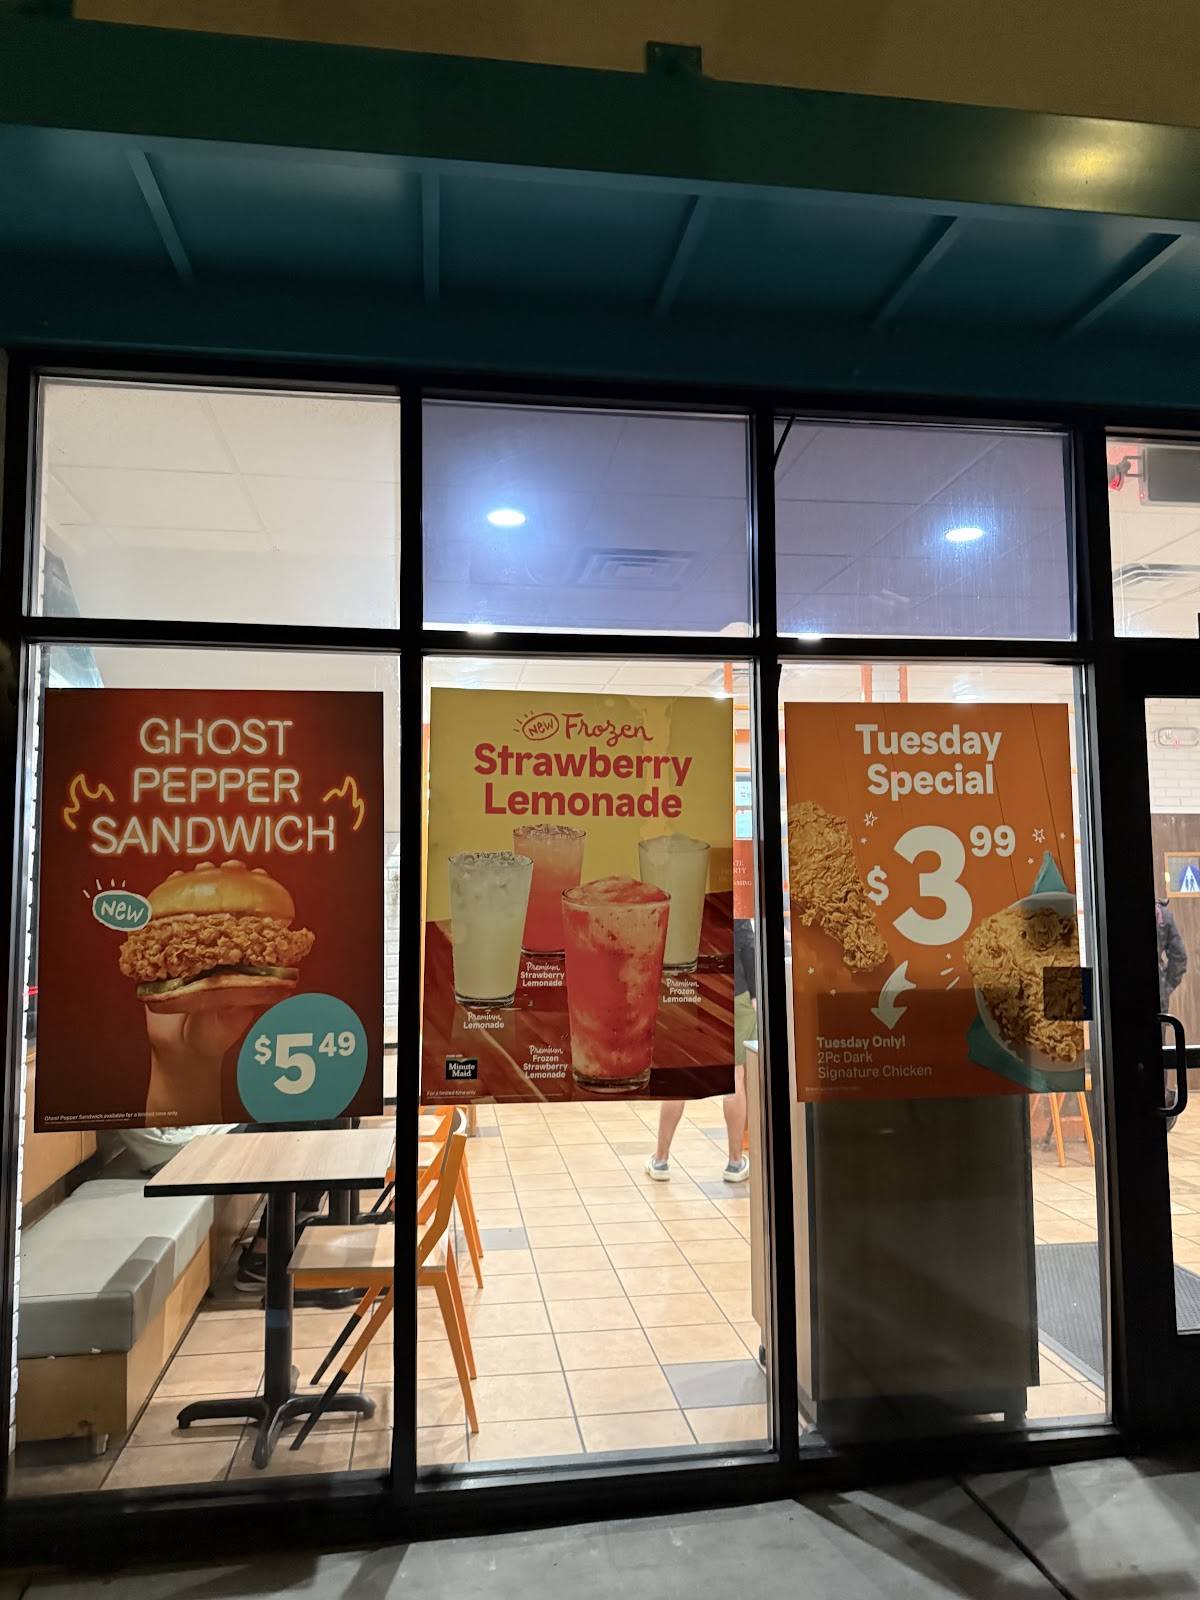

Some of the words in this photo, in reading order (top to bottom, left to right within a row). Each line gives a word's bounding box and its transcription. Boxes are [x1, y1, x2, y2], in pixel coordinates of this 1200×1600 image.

[561, 712, 653, 747] Frozen
[139, 717, 293, 756] GHOST
[855, 723, 1003, 762] Tuesday
[474, 742, 692, 786] Strawberry
[132, 767, 300, 803] PEPPER
[867, 762, 995, 800] Special
[484, 782, 682, 818] Lemonade
[91, 815, 336, 855] SANDWICH
[526, 962, 560, 971] Premium
[520, 971, 565, 980] Strawberry
[666, 978, 699, 987] Premium
[670, 987, 695, 995] Frozen
[662, 995, 702, 1003] Lemonade
[467, 1011, 502, 1022] Premium
[463, 1021, 504, 1029] Lemonade
[816, 1036, 869, 1050] Tuesday
[872, 1035, 906, 1049] Only!
[529, 1045, 563, 1055] Premium
[817, 1051, 841, 1064] 2Pc
[843, 1051, 873, 1063] Dark
[448, 1062, 476, 1070] Minute
[523, 1062, 568, 1071] Strawberry
[451, 1069, 472, 1077] Maid
[525, 1071, 566, 1079] Lemonade
[818, 1066, 880, 1081] Signature
[882, 1064, 933, 1078] Chicken
